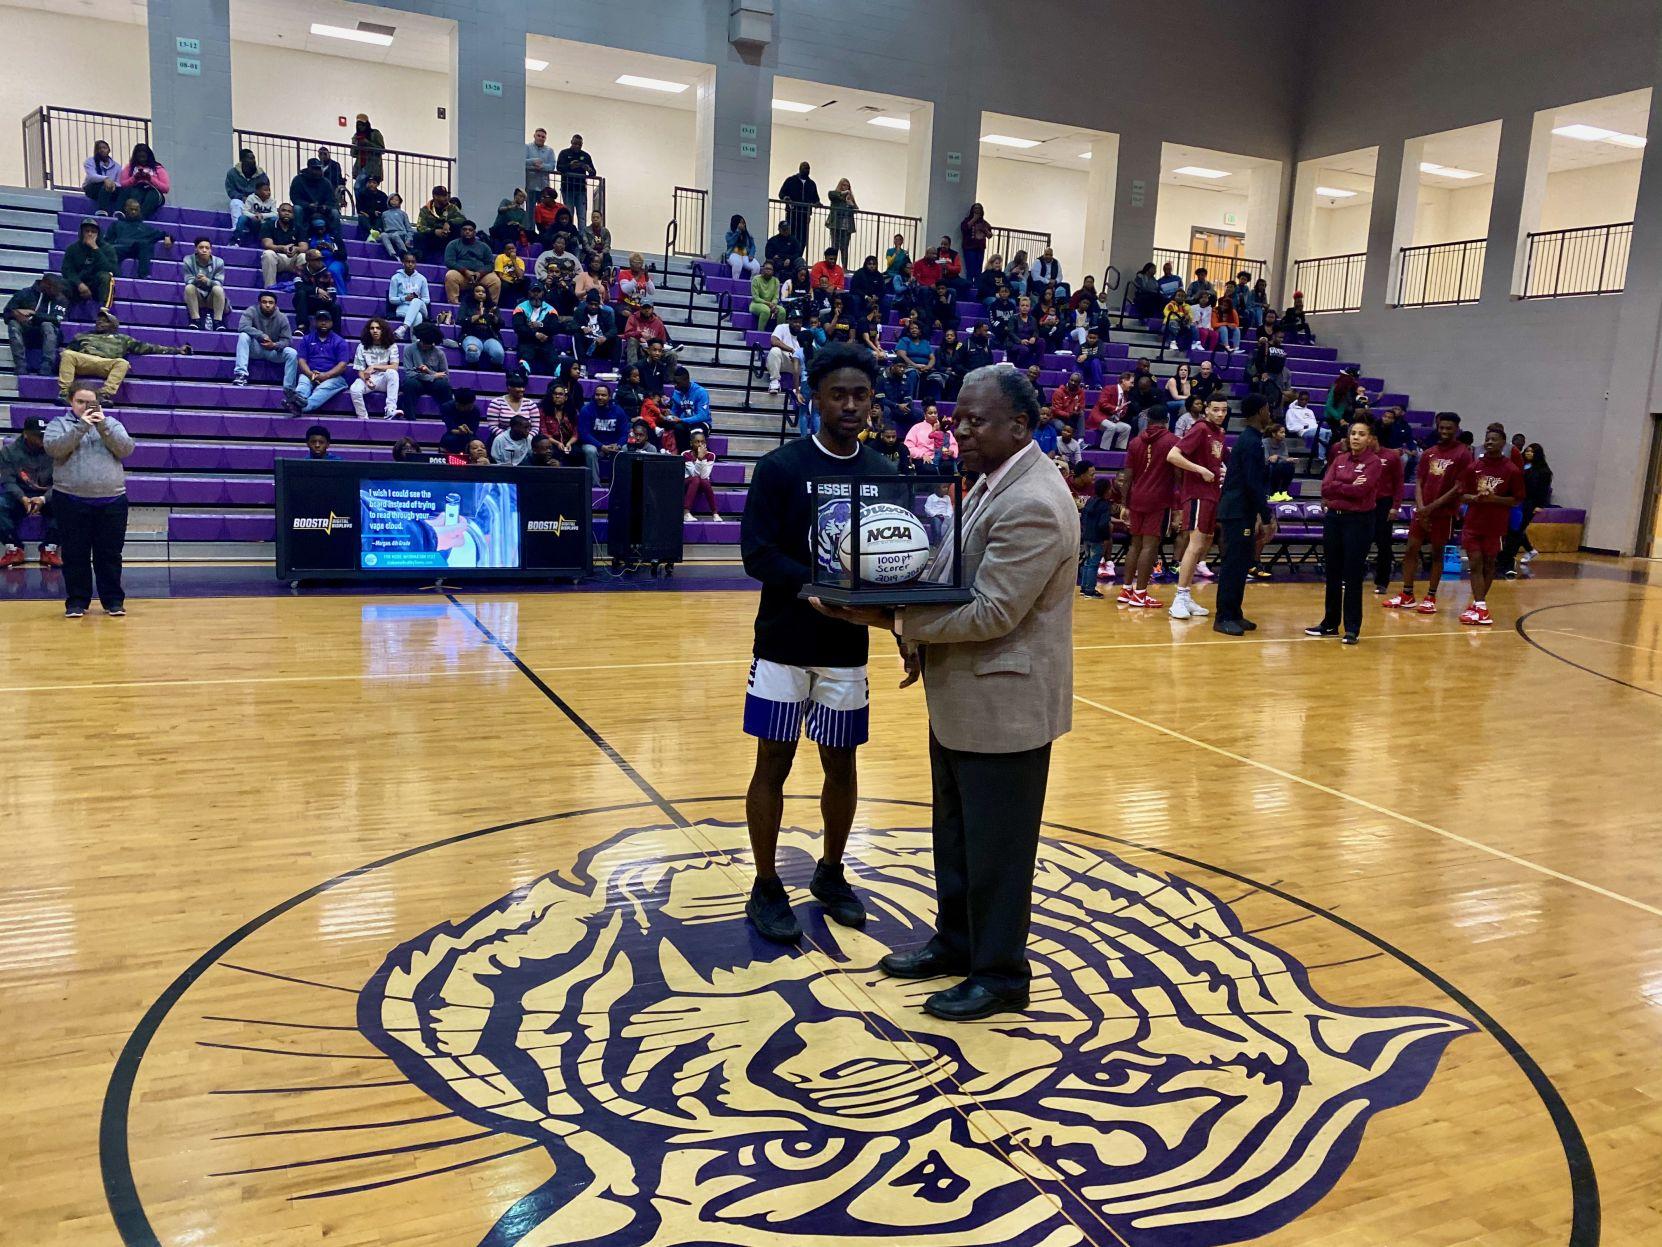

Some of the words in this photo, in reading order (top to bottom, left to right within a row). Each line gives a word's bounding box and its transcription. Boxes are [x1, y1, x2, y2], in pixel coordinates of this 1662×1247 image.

[372, 488, 388, 497] wish
[392, 489, 409, 498] could
[421, 490, 432, 499] the
[387, 500, 410, 509] instead
[411, 500, 418, 508] of
[418, 501, 436, 511] trying
[369, 511, 376, 519] to
[391, 511, 415, 521] through
[415, 513, 430, 521] your
[293, 518, 330, 528] BOOSTR
[369, 523, 384, 532] vape
[527, 520, 559, 530] BOOSTR
[867, 526, 913, 543] NCAA
[877, 555, 901, 565] 1000
[901, 553, 913, 565] pt
[875, 563, 911, 573] Scorer
